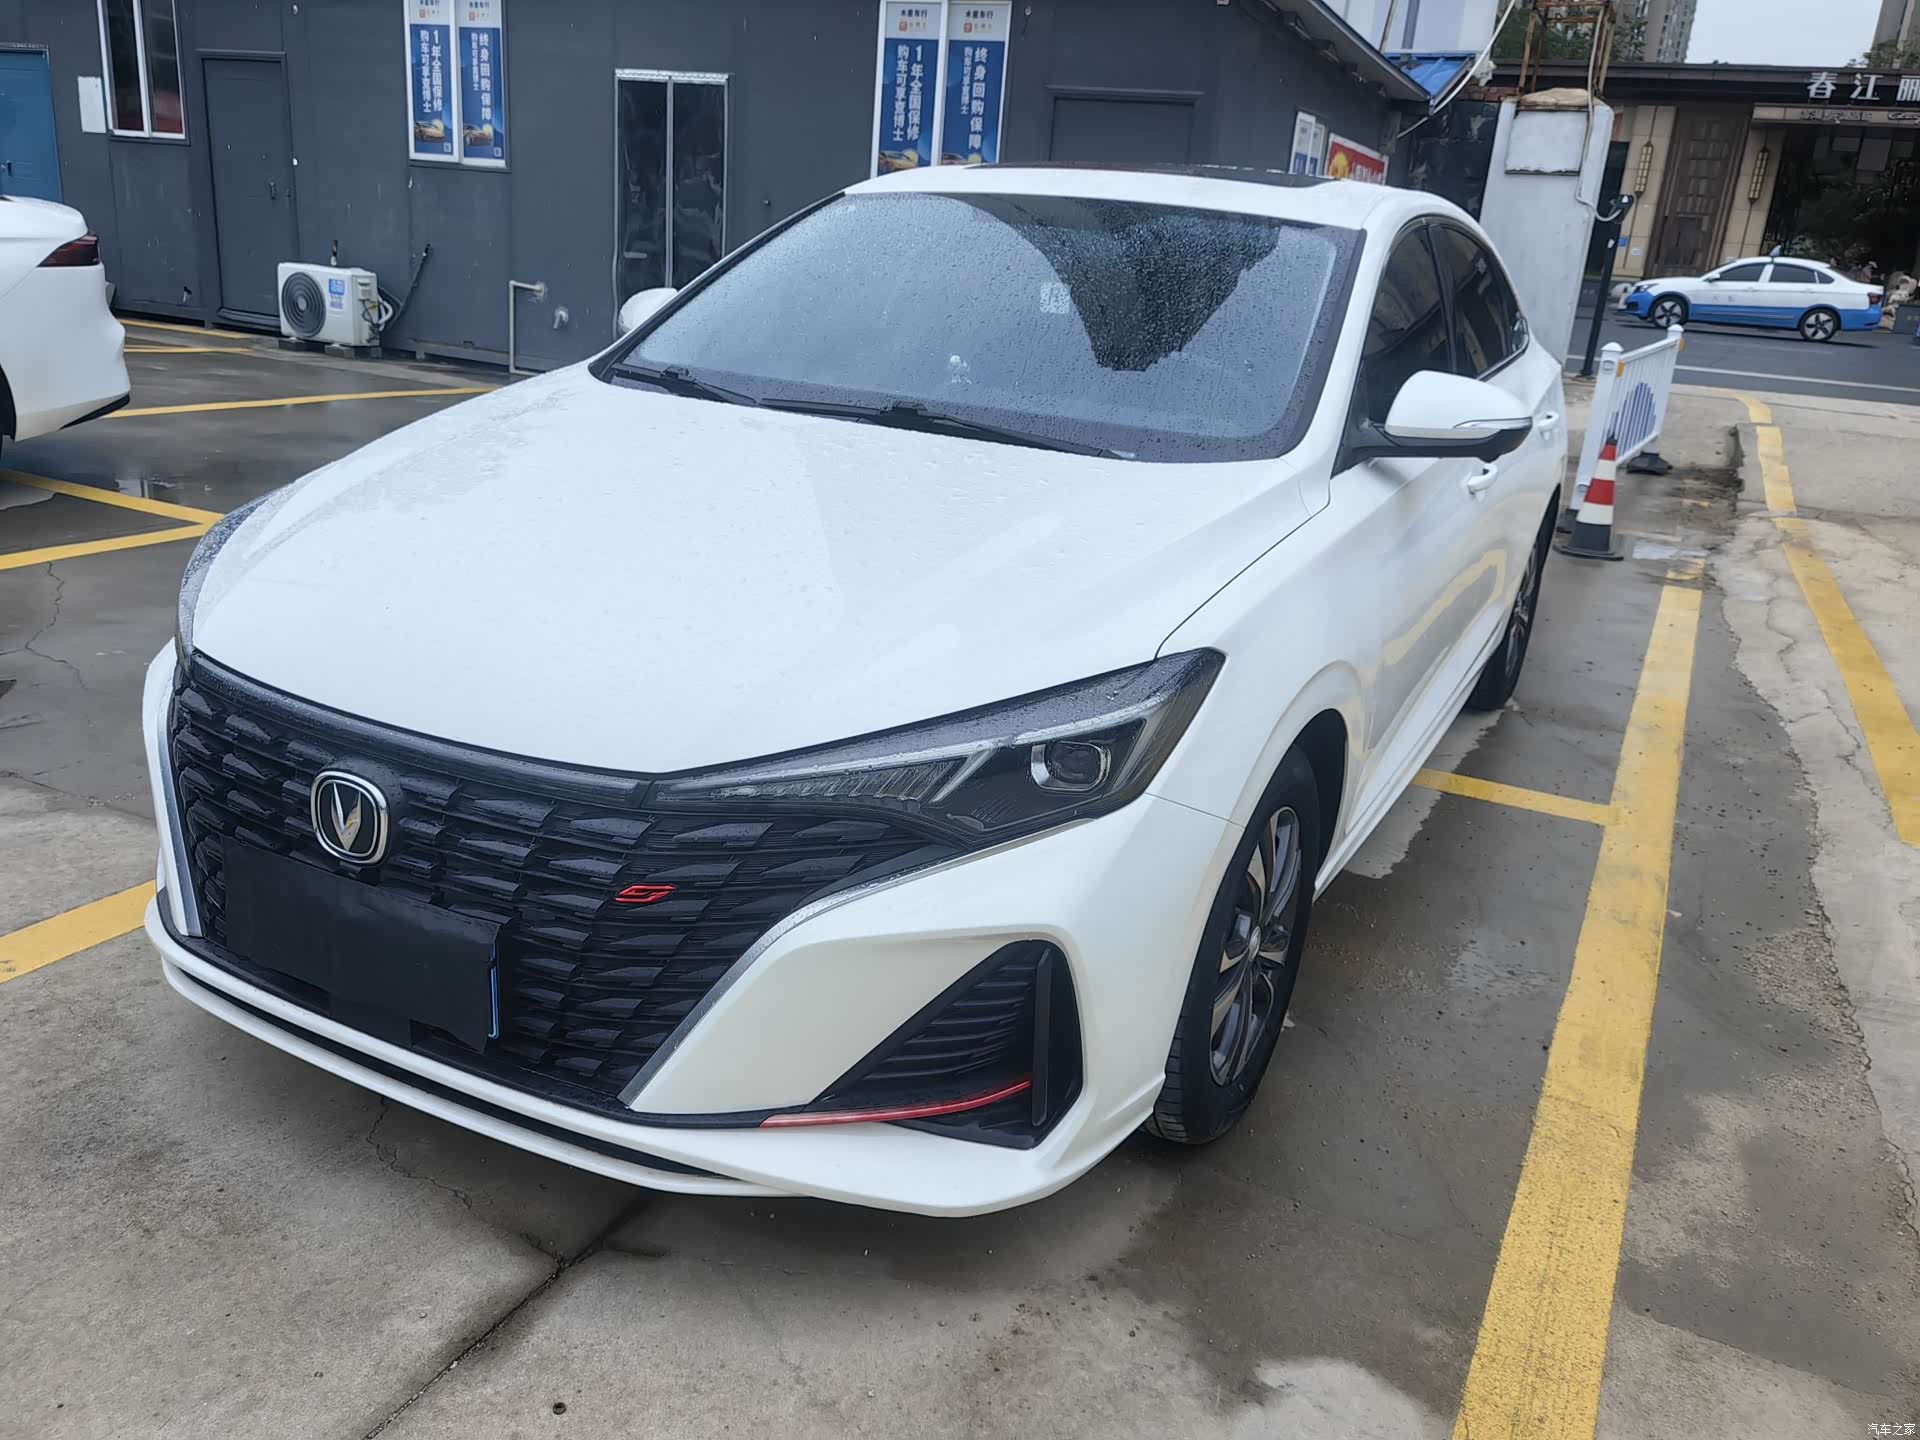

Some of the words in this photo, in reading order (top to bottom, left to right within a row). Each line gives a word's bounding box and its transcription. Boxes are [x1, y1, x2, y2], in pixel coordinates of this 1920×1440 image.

[431, 29, 443, 113] 1年全国保修
[906, 44, 924, 142] 1年全国保修
[968, 47, 989, 151] 终身回购保障
